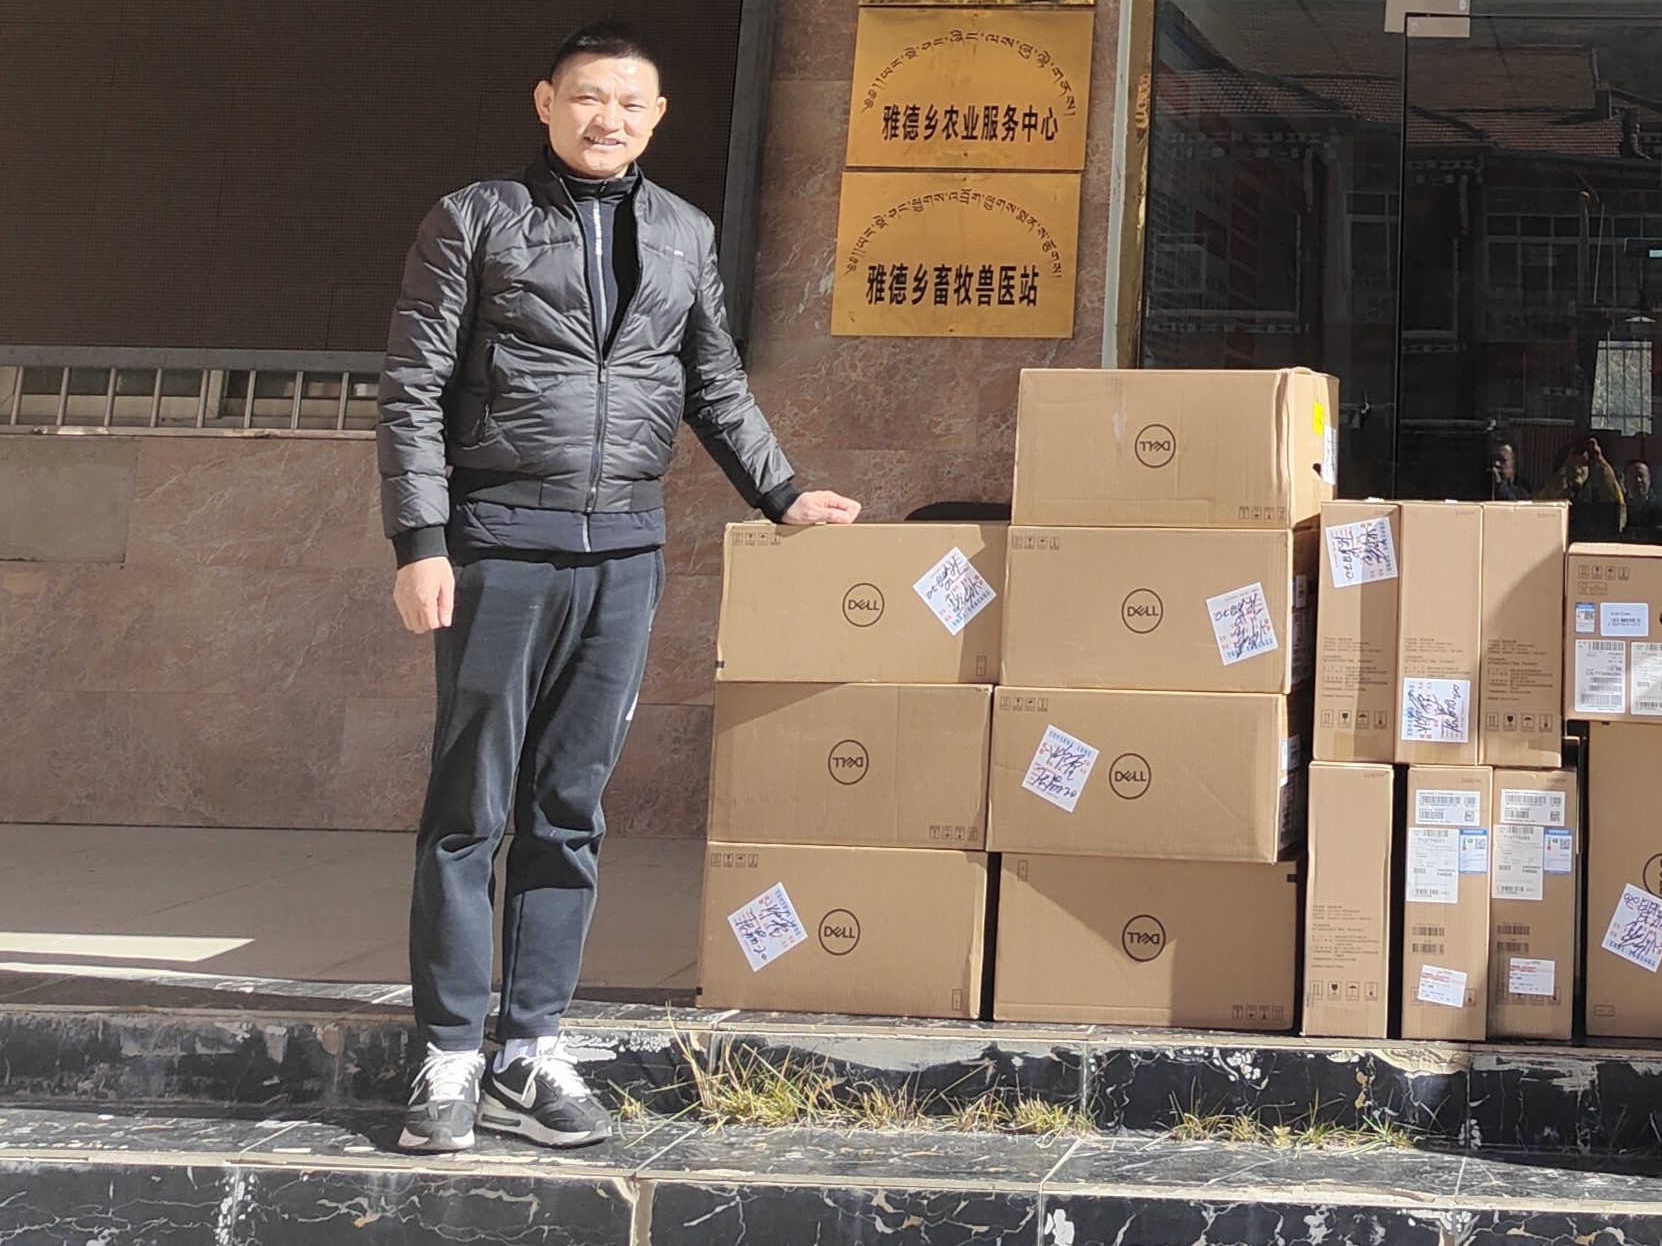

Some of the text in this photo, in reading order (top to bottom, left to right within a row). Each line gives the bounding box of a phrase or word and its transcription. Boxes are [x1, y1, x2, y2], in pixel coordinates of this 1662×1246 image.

[881, 103, 1059, 143] 雅德乡农业服务中心
[865, 262, 1040, 307] 雅德乡畜牧兽医站
[1139, 441, 1170, 451] DELL
[848, 600, 879, 610] DELL
[1127, 606, 1159, 617] DELL
[833, 757, 863, 768] DELL
[1115, 771, 1147, 782] DELL
[824, 926, 855, 938] DELL
[1127, 932, 1160, 944] DELL
